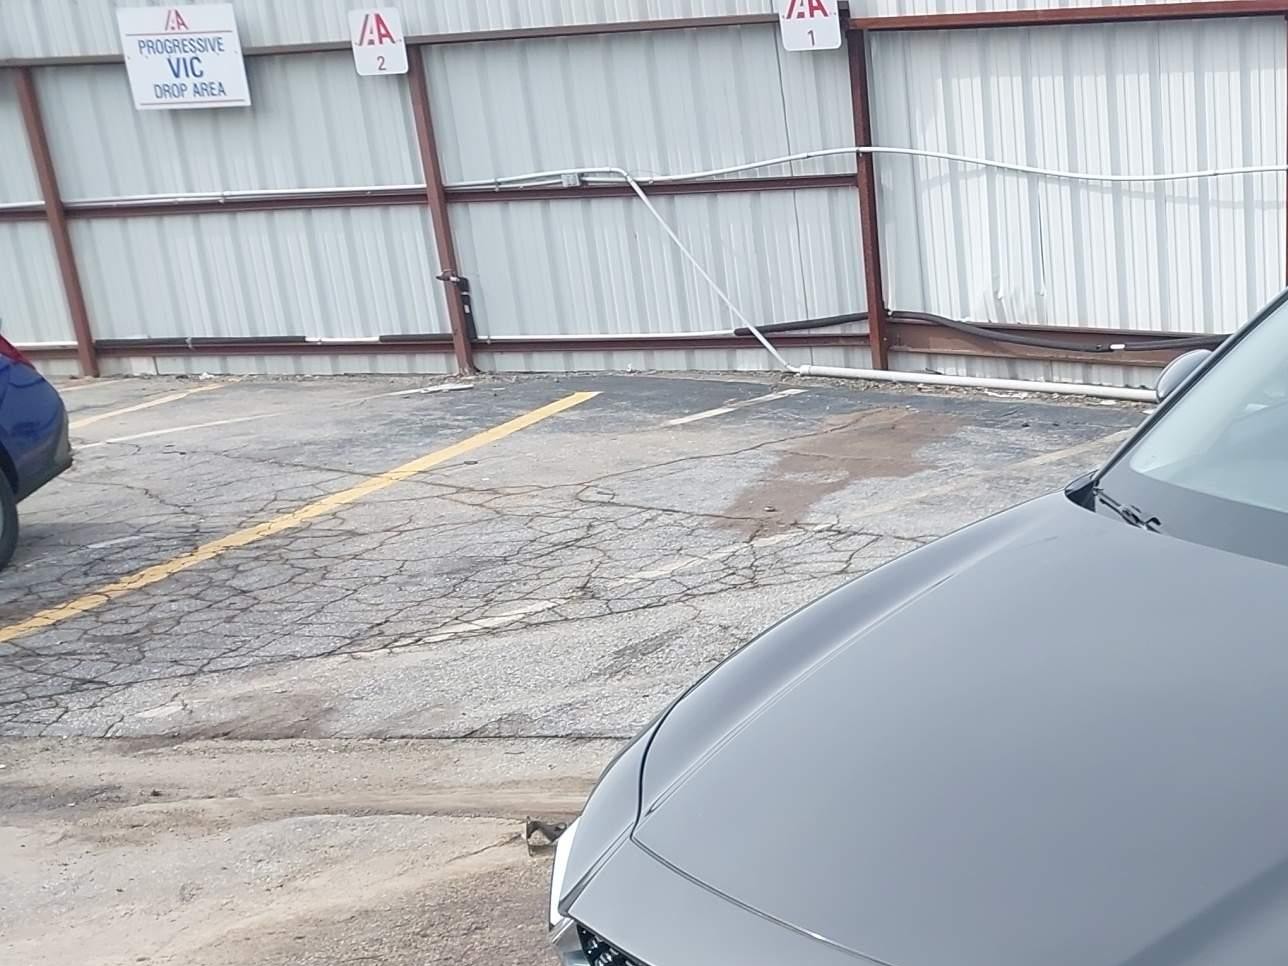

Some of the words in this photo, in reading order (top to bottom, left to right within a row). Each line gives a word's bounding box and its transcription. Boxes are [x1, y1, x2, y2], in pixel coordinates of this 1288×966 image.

[138, 37, 225, 55] PROGRESSIVE
[807, 29, 816, 47] 1
[167, 56, 205, 79] VIC
[376, 56, 386, 71] 2
[154, 83, 188, 100] DROP
[192, 81, 227, 97] AREA
